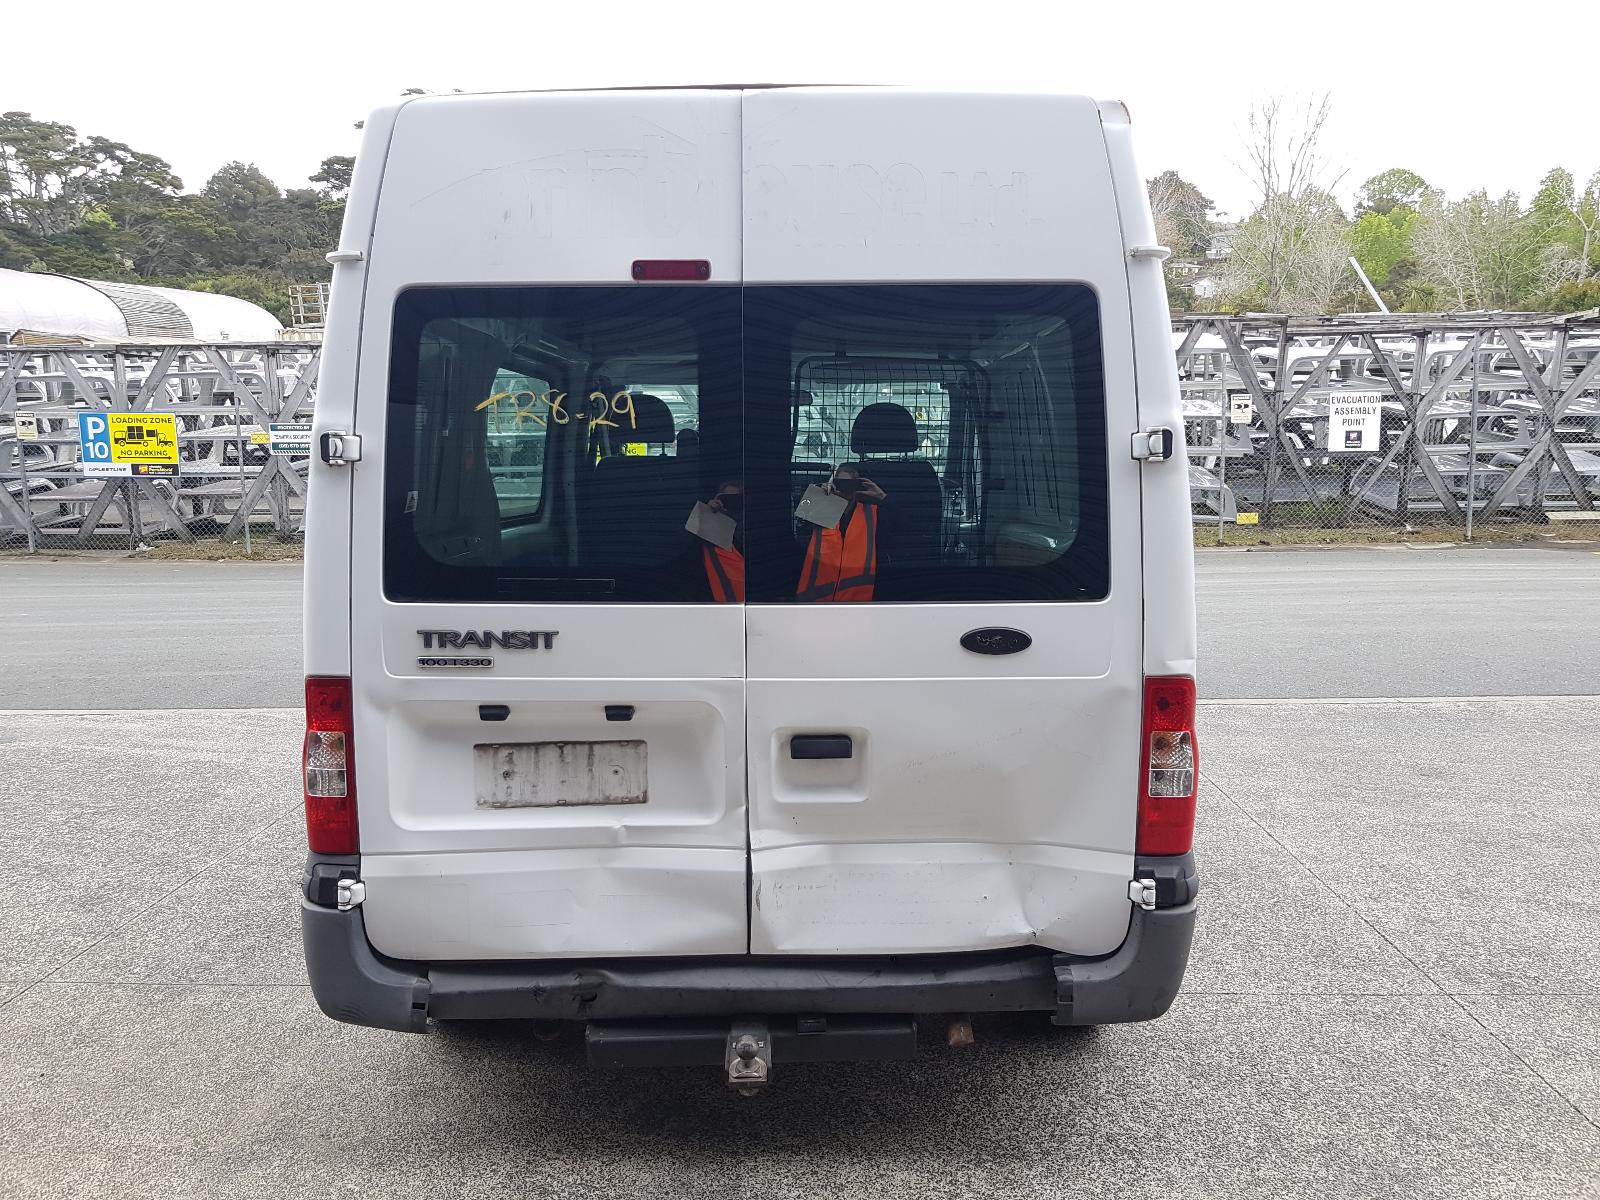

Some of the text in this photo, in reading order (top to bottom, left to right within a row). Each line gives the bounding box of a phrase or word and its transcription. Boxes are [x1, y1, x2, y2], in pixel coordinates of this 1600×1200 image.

[1331, 395, 1381, 404] EVACUATION
[1334, 407, 1377, 415] ASSEMBLY
[1342, 418, 1366, 426] POINT
[86, 416, 105, 440] P
[85, 441, 109, 459] 10
[134, 449, 168, 457] PARKING
[416, 629, 560, 650] TRANSIT
